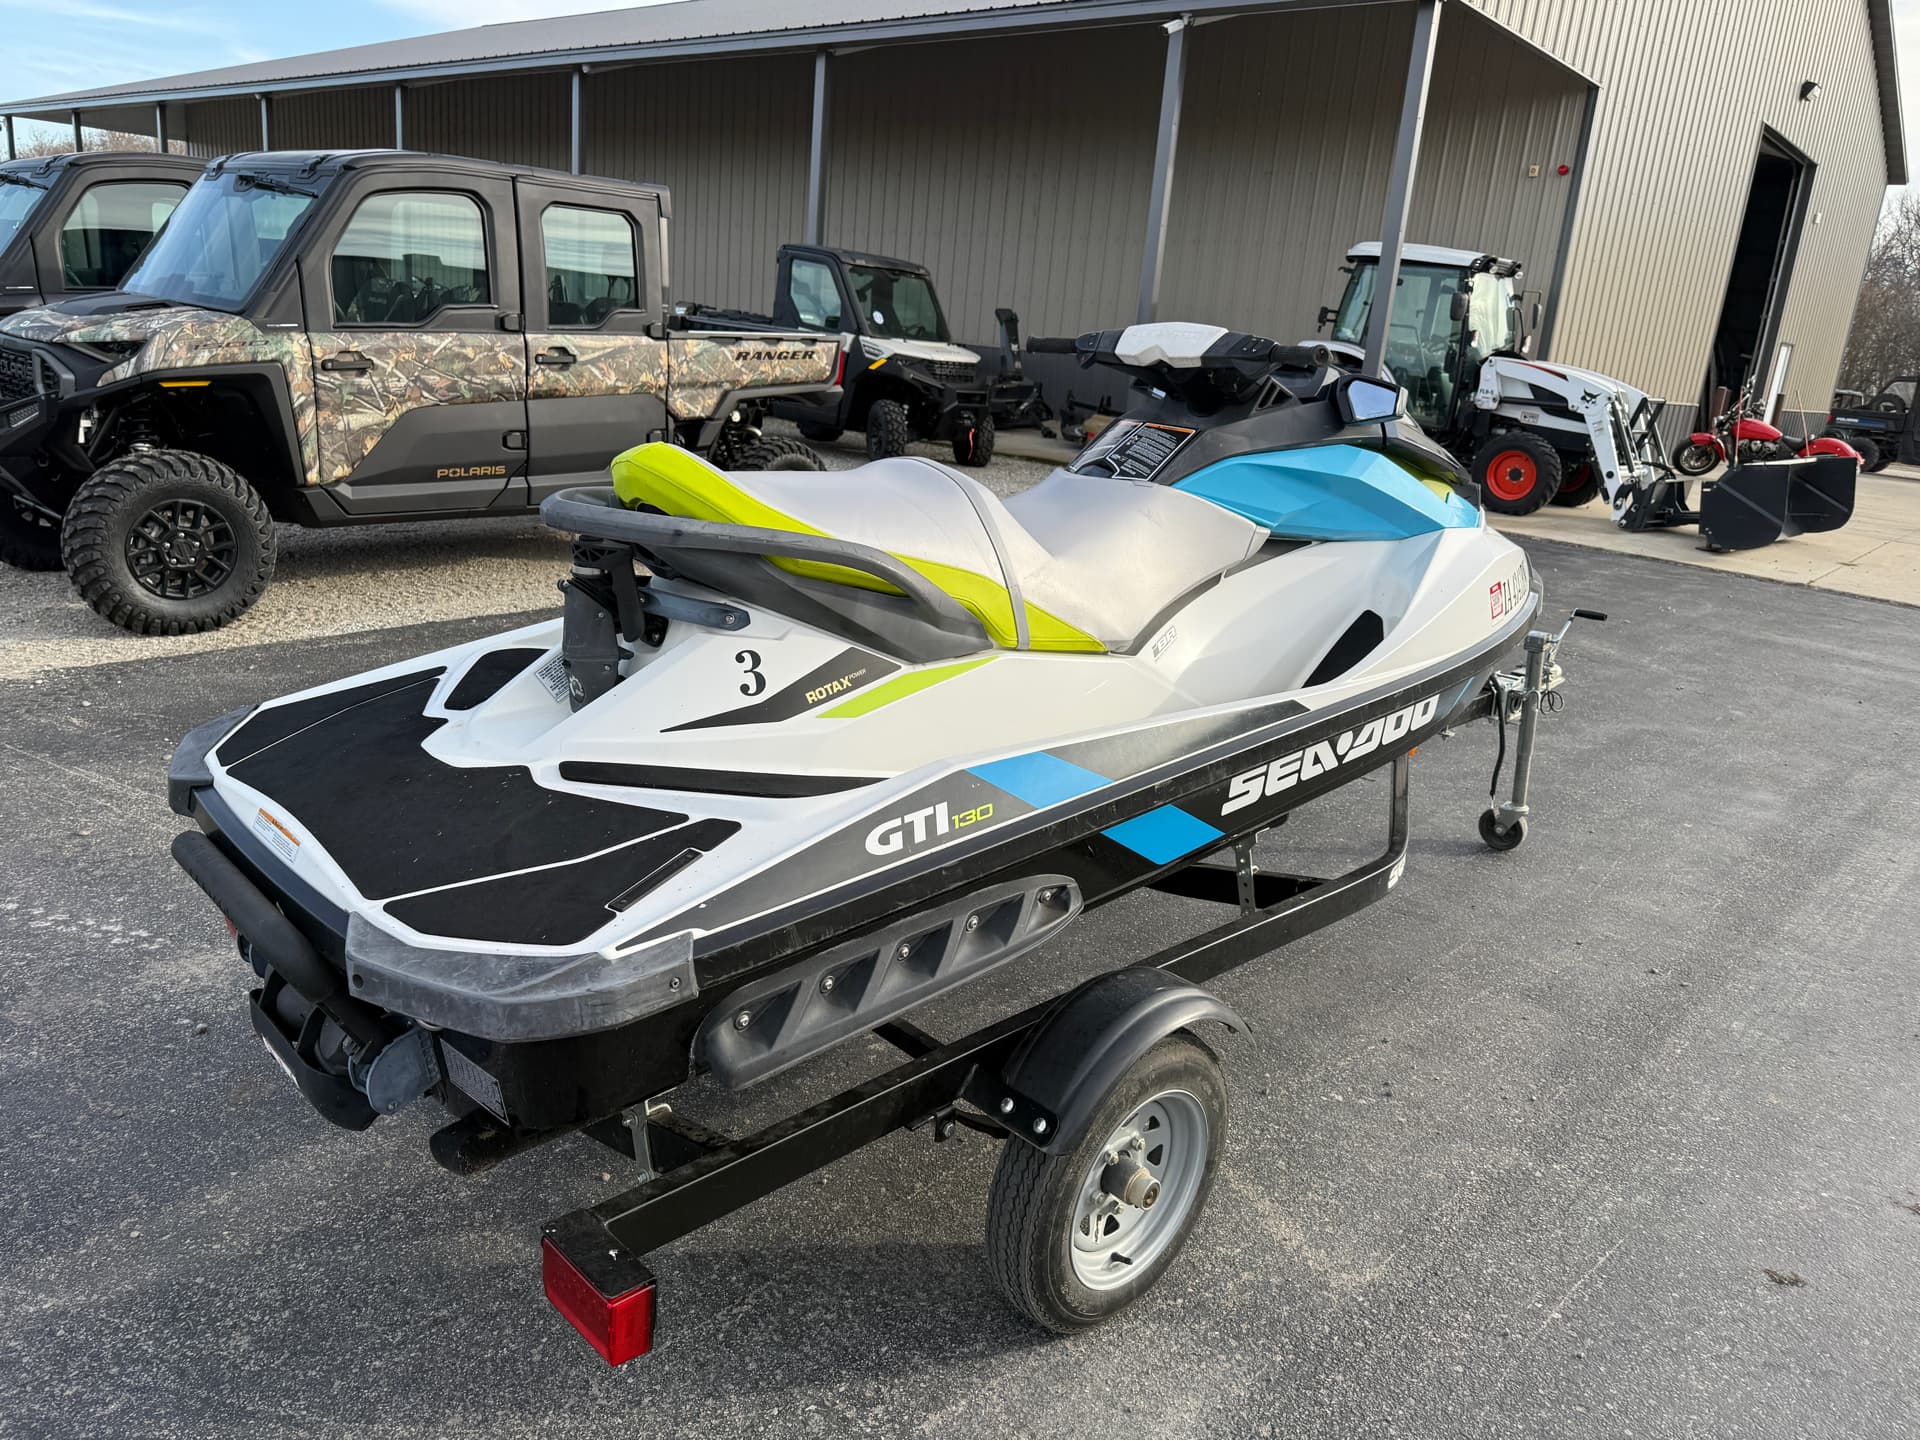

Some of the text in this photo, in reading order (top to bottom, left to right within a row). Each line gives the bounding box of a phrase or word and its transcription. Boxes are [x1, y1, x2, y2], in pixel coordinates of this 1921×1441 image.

[735, 350, 816, 361] RANGER
[436, 465, 506, 479] POLARIS
[735, 649, 766, 697] 3
[805, 667, 866, 704] ROTAX POWER
[864, 801, 993, 856] GTI 130
